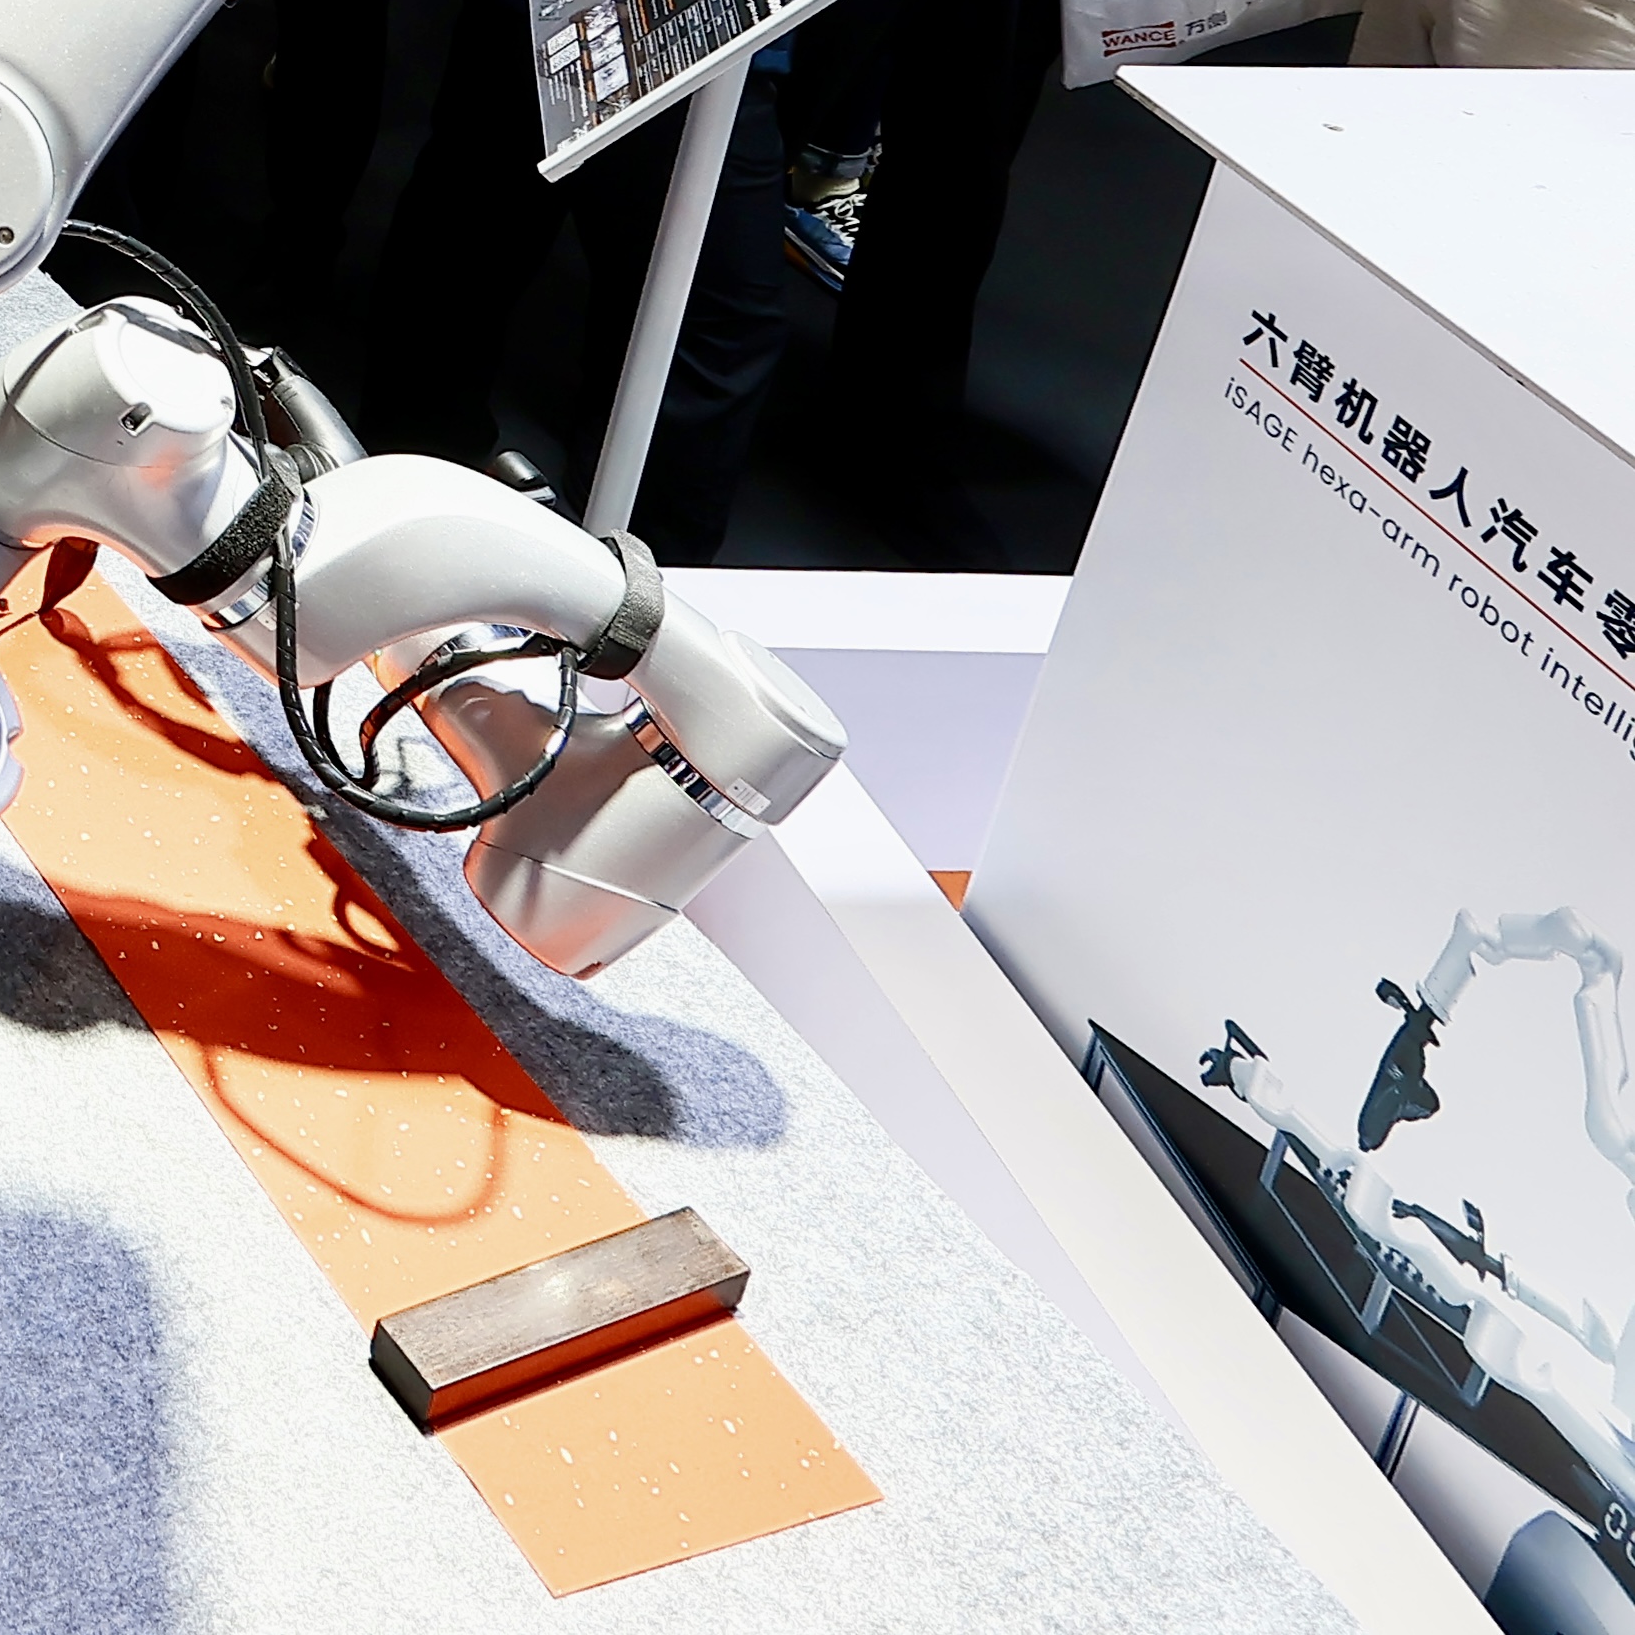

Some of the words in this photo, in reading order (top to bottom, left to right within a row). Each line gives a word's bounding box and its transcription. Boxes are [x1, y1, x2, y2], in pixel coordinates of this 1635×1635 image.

[1103, 28, 1177, 48] WANCE
[1224, 376, 1299, 454] iSAGE
[1301, 443, 1442, 579] hexa-arm
[1447, 571, 1536, 658] robot
